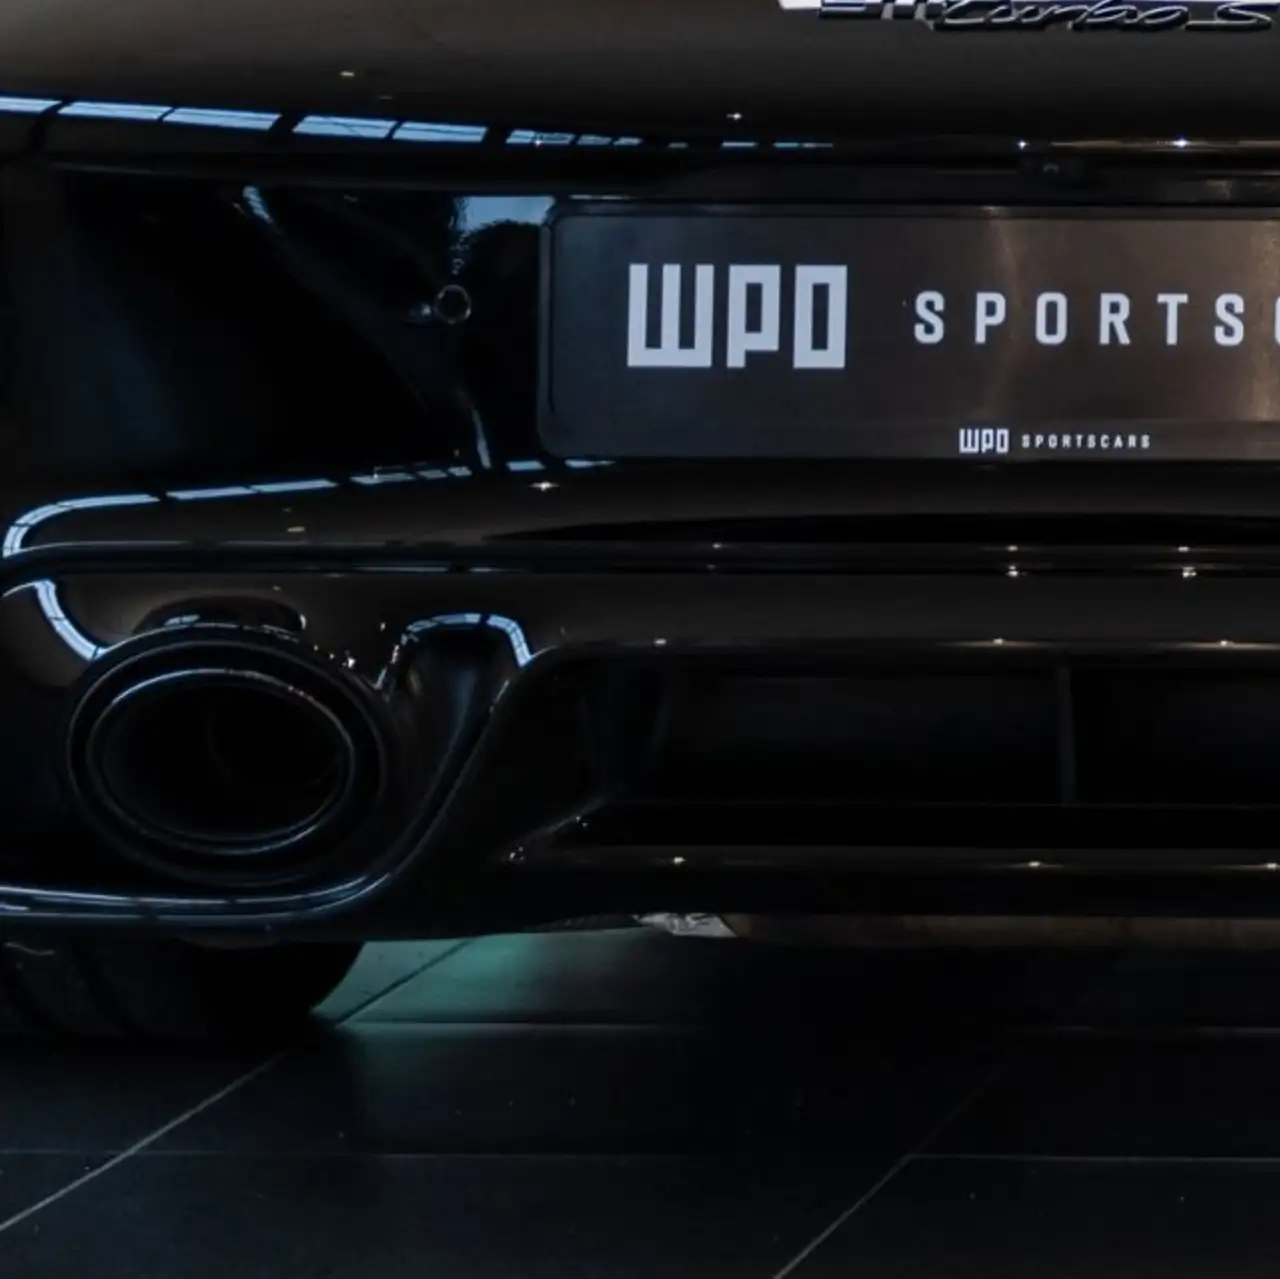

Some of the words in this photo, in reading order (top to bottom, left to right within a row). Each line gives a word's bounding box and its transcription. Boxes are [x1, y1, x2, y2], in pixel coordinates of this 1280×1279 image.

[1186, 1, 1279, 31] S
[628, 264, 848, 368] WPO
[959, 428, 1010, 454] WPO
[1022, 433, 1150, 449] SPORTSCARS
